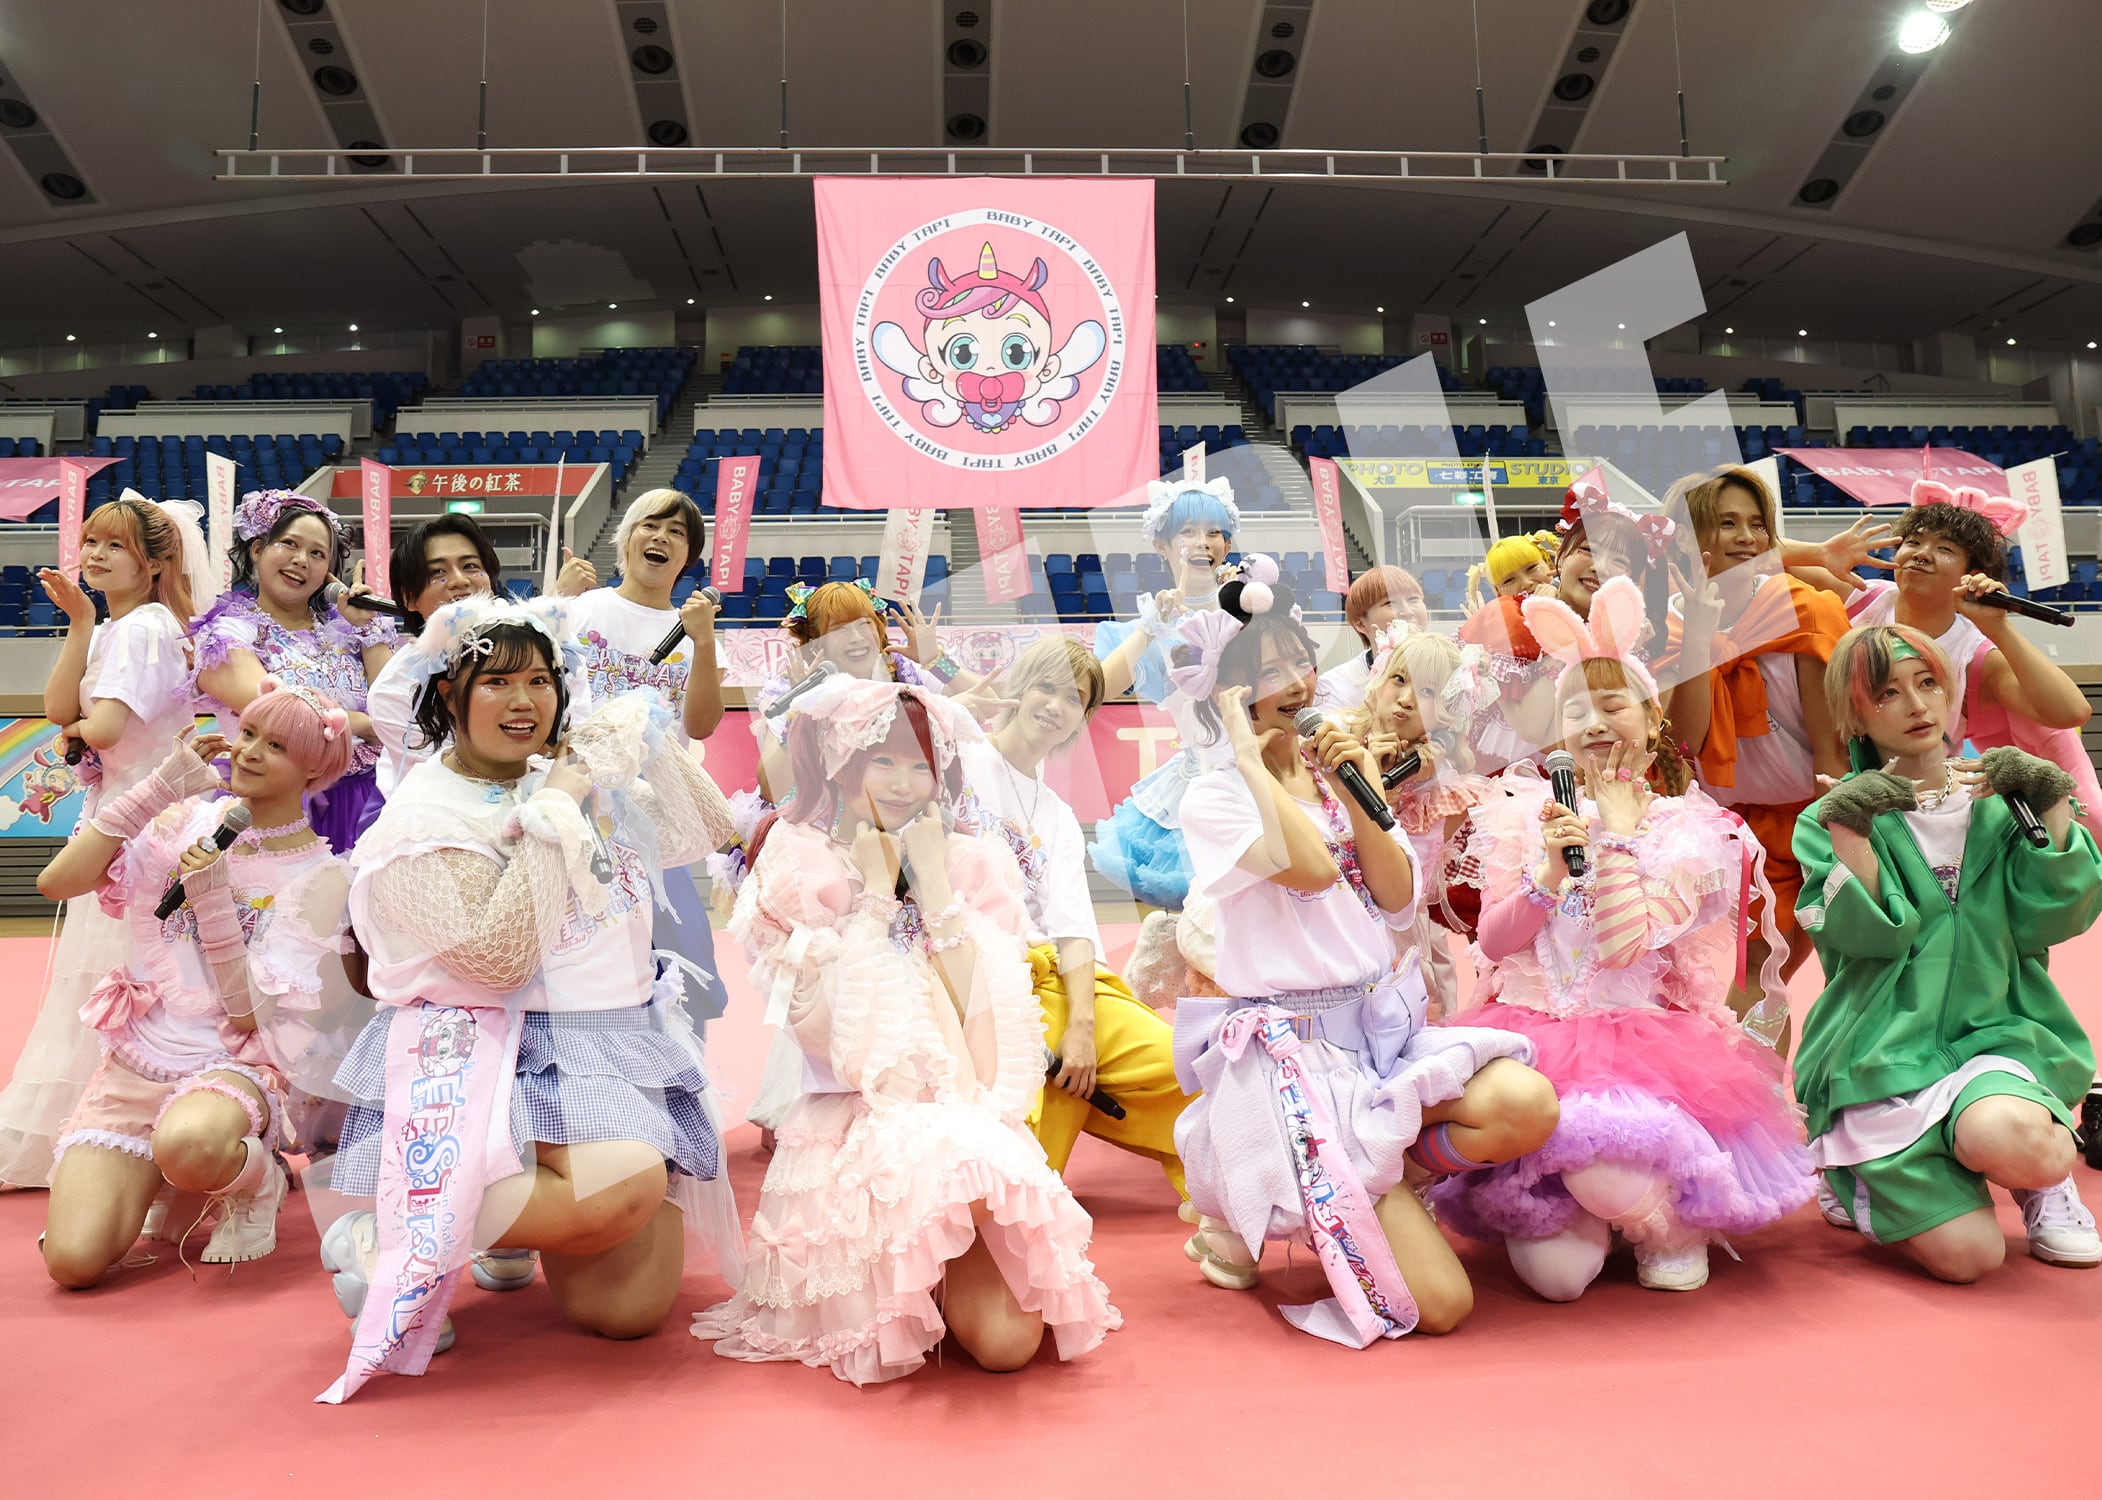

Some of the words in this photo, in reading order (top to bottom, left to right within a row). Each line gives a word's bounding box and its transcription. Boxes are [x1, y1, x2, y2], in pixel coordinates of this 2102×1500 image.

[874, 240, 907, 279] BABY
[912, 218, 951, 241] TAPI
[986, 211, 1033, 228] BABY
[1041, 225, 1078, 251] TAPI
[856, 289, 875, 327] TAPI
[1082, 259, 1114, 298] BABY
[1109, 306, 1122, 345] TAPI
[855, 337, 873, 382] BABY
[1099, 360, 1122, 404] BABY
[871, 394, 901, 430] TAPI
[1067, 409, 1101, 442] TAPI
[904, 432, 949, 460] BABY
[962, 456, 1005, 469] TAPI
[1014, 443, 1058, 467] BABY
[5, 478, 60, 488] TAP
[431, 472, 522, 493] 午後の紅茶
[1510, 463, 1589, 476] STUDIO
[1815, 466, 1896, 477] BABY
[1939, 466, 2006, 477] TAPI
[727, 465, 747, 515] BABY
[906, 508, 921, 530] BY
[717, 541, 735, 587] TAPI
[893, 554, 915, 597] TAPI
